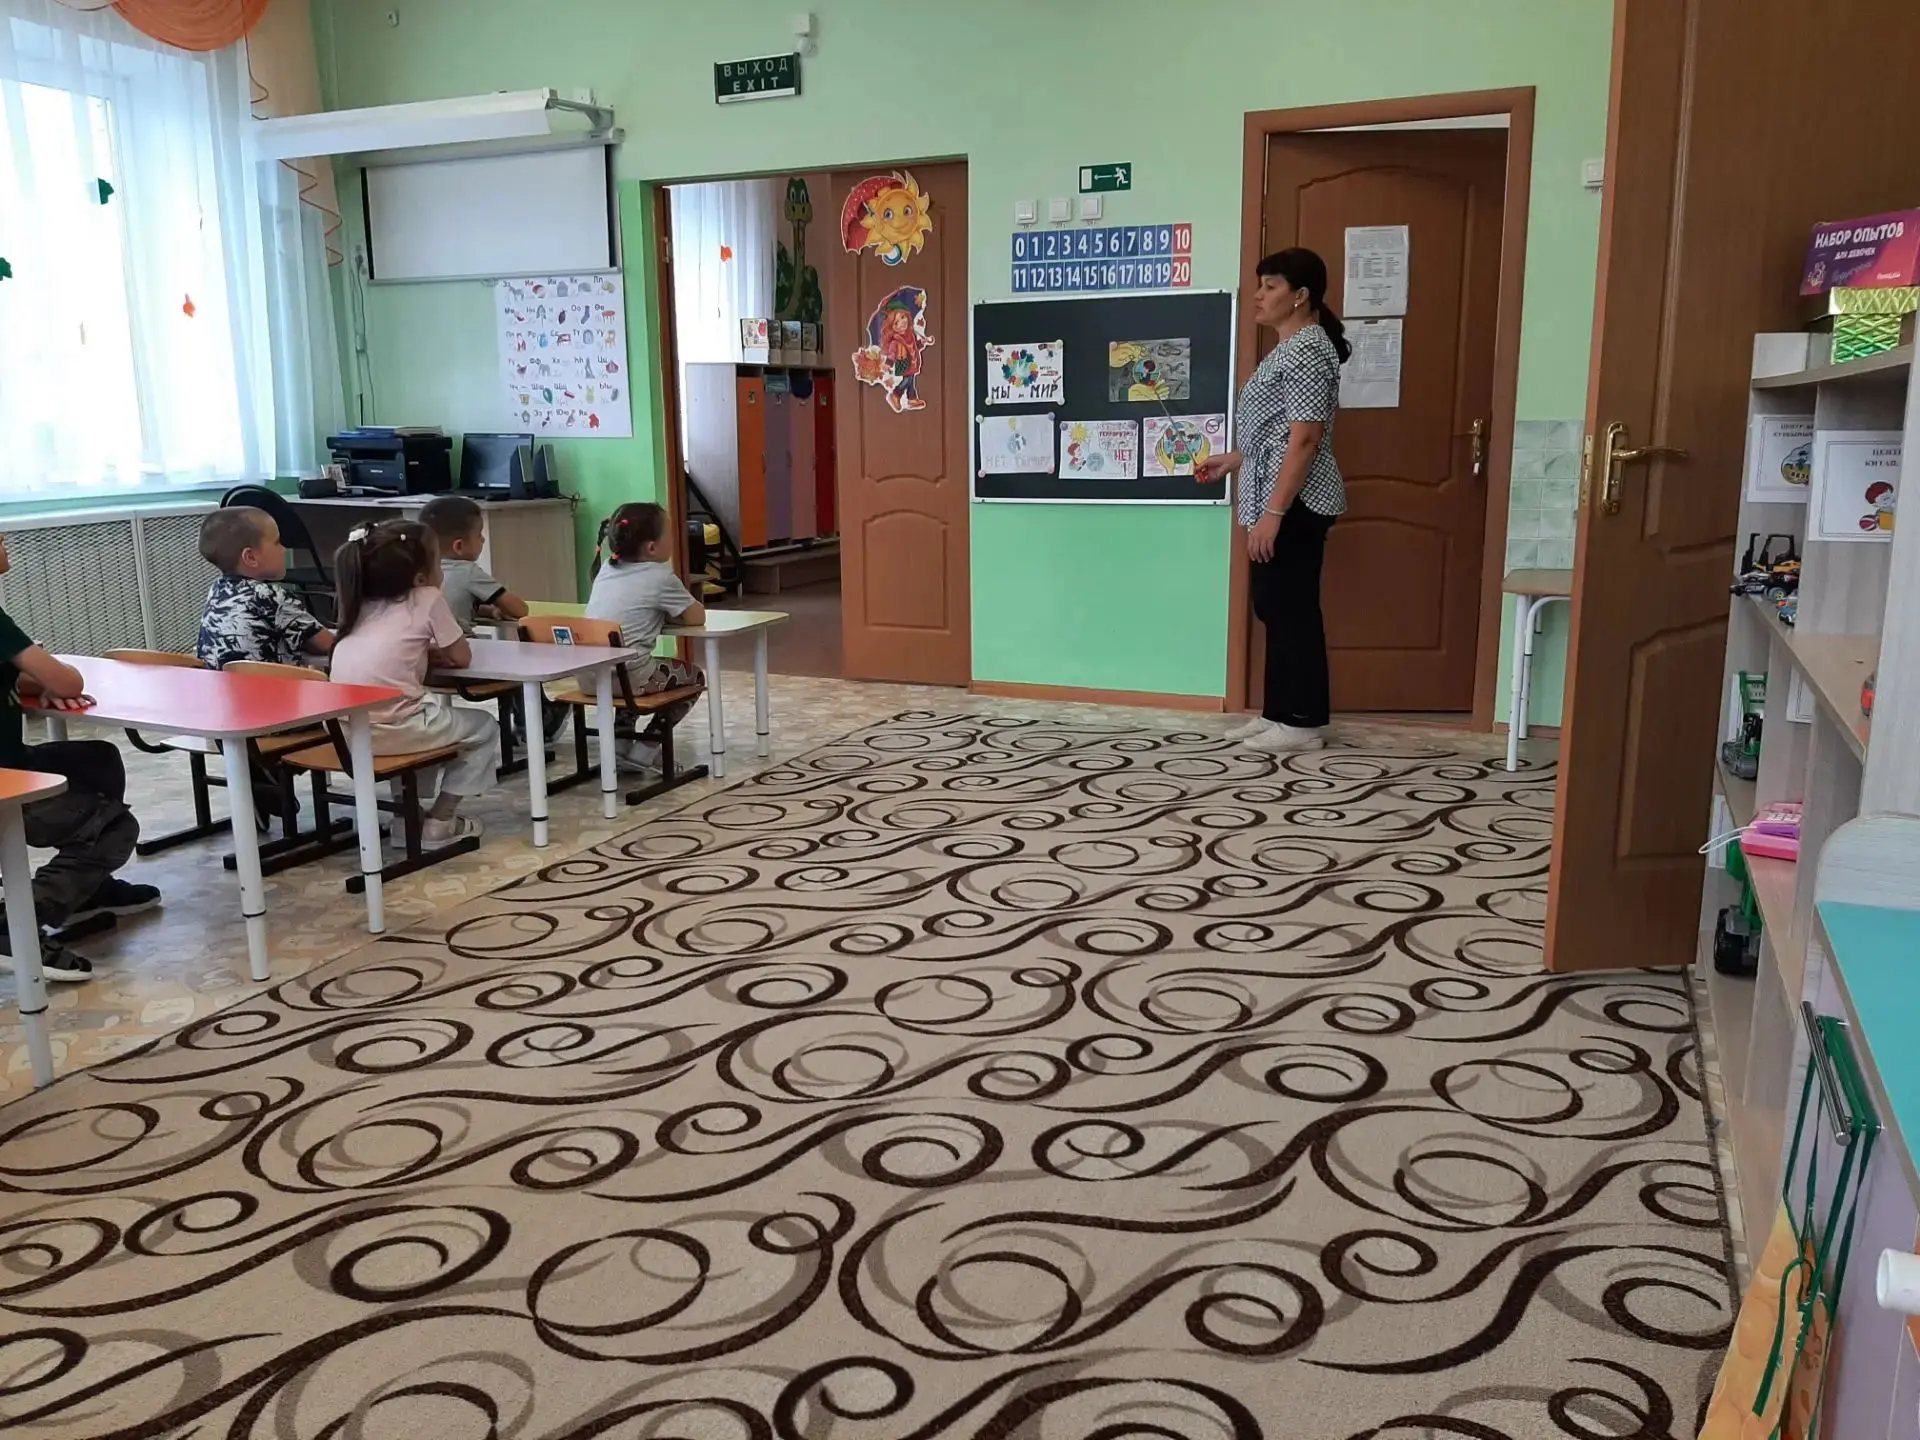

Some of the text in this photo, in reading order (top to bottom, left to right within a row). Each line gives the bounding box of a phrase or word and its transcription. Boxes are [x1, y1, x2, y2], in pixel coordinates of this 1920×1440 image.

[723, 58, 788, 77] ВЫХОД
[733, 76, 779, 92] EXIT
[1015, 228, 1190, 257] 0 1 2 3 4 5 6 7 8 9 10
[1815, 221, 1905, 249] НАБОР ОПЫТОВ
[1013, 262, 1189, 288] 11 12 13 14 15 16 17 18 19 20
[991, 385, 1011, 400] МЫ
[1030, 383, 1059, 399] МИР
